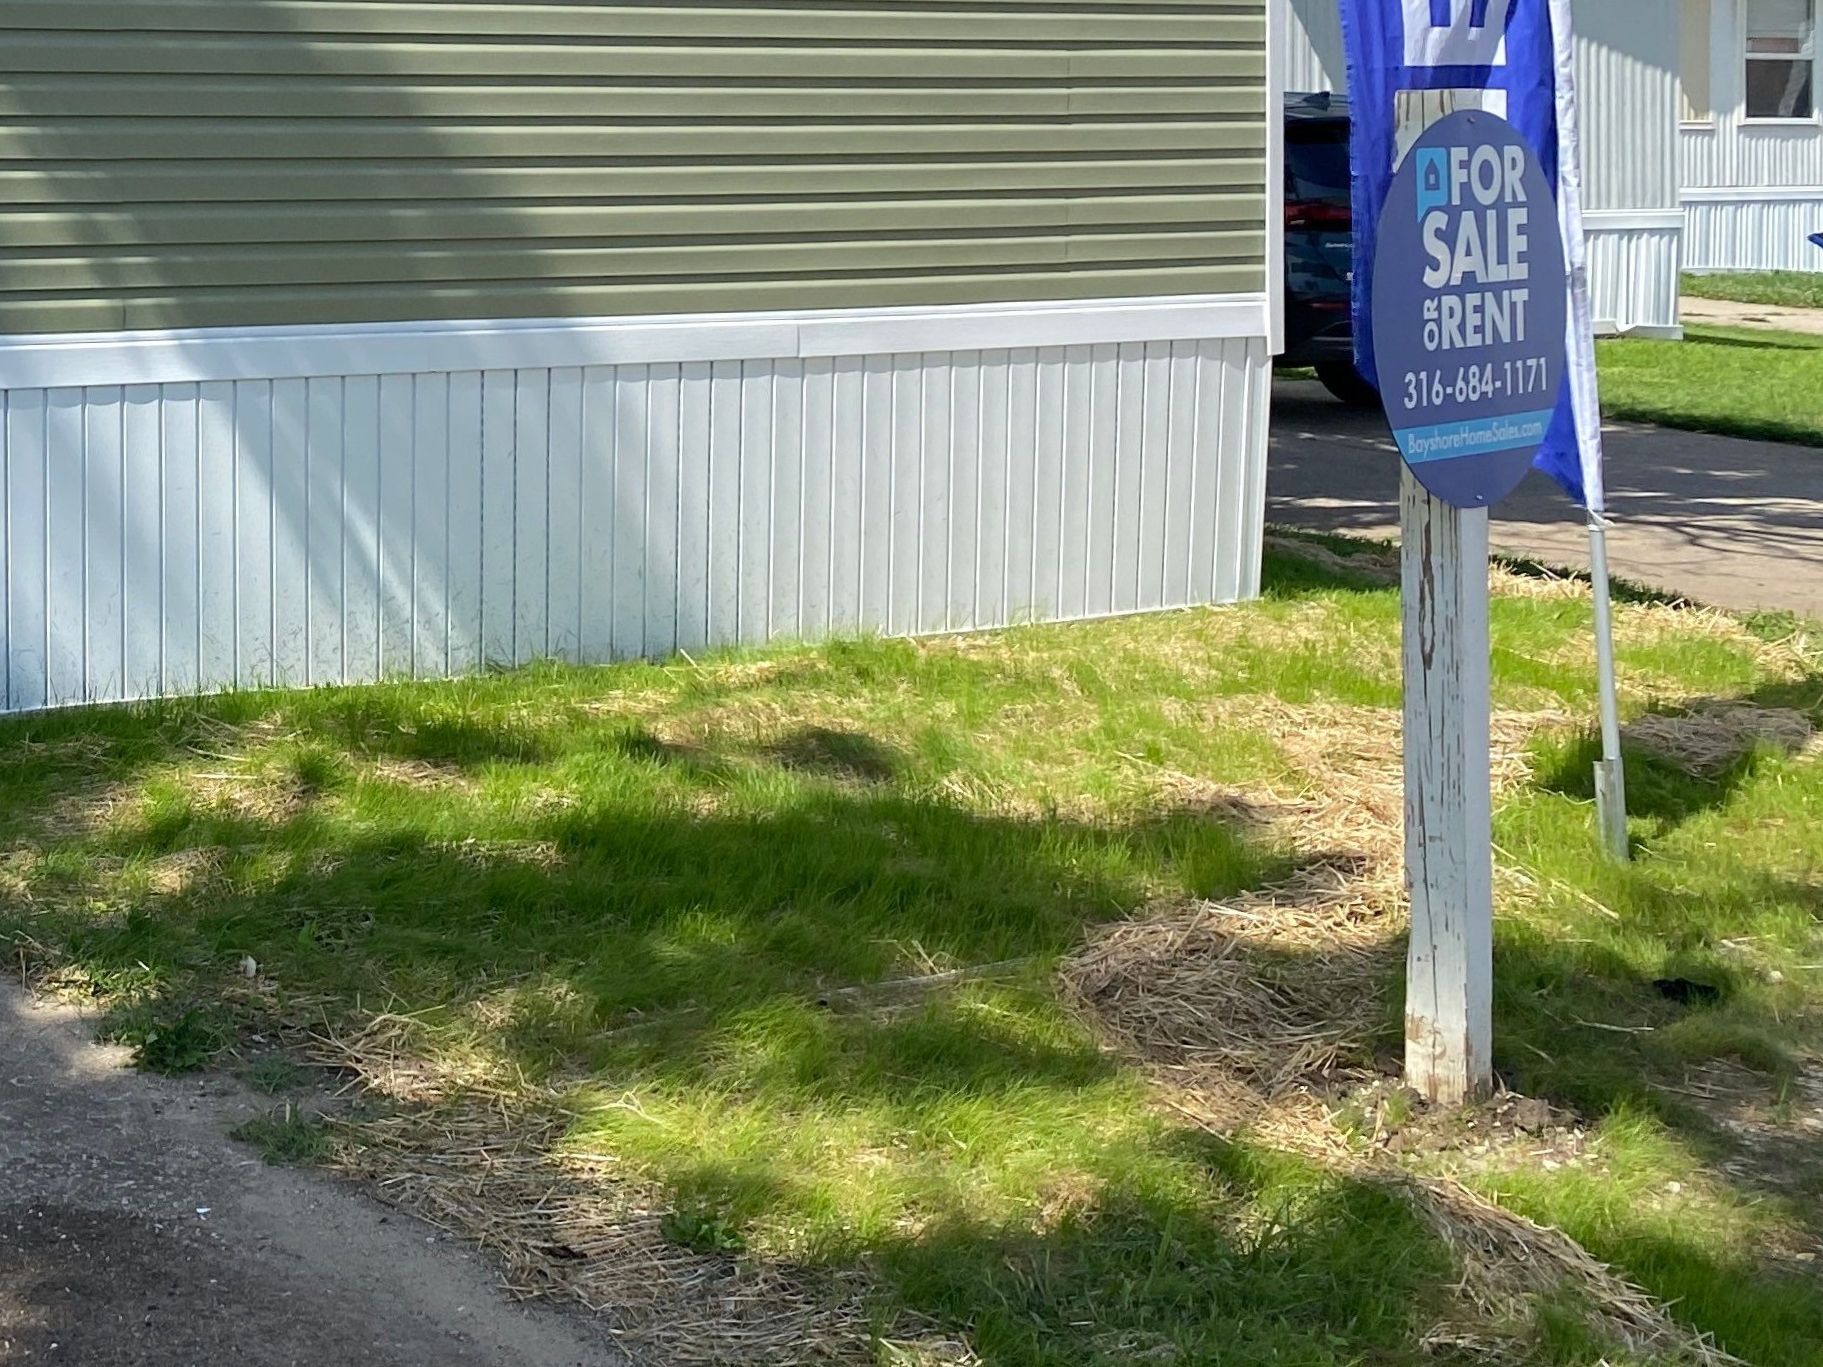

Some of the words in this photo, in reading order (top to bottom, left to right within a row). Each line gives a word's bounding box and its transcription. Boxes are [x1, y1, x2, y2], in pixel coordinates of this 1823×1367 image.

[1450, 144, 1528, 206] FOR
[1422, 207, 1529, 289] SALE
[1423, 296, 1440, 352] OR
[1440, 288, 1530, 350] RENT
[1403, 357, 1548, 410] 316-684-1171
[1407, 420, 1544, 459] BayshoreHomeSales.com
